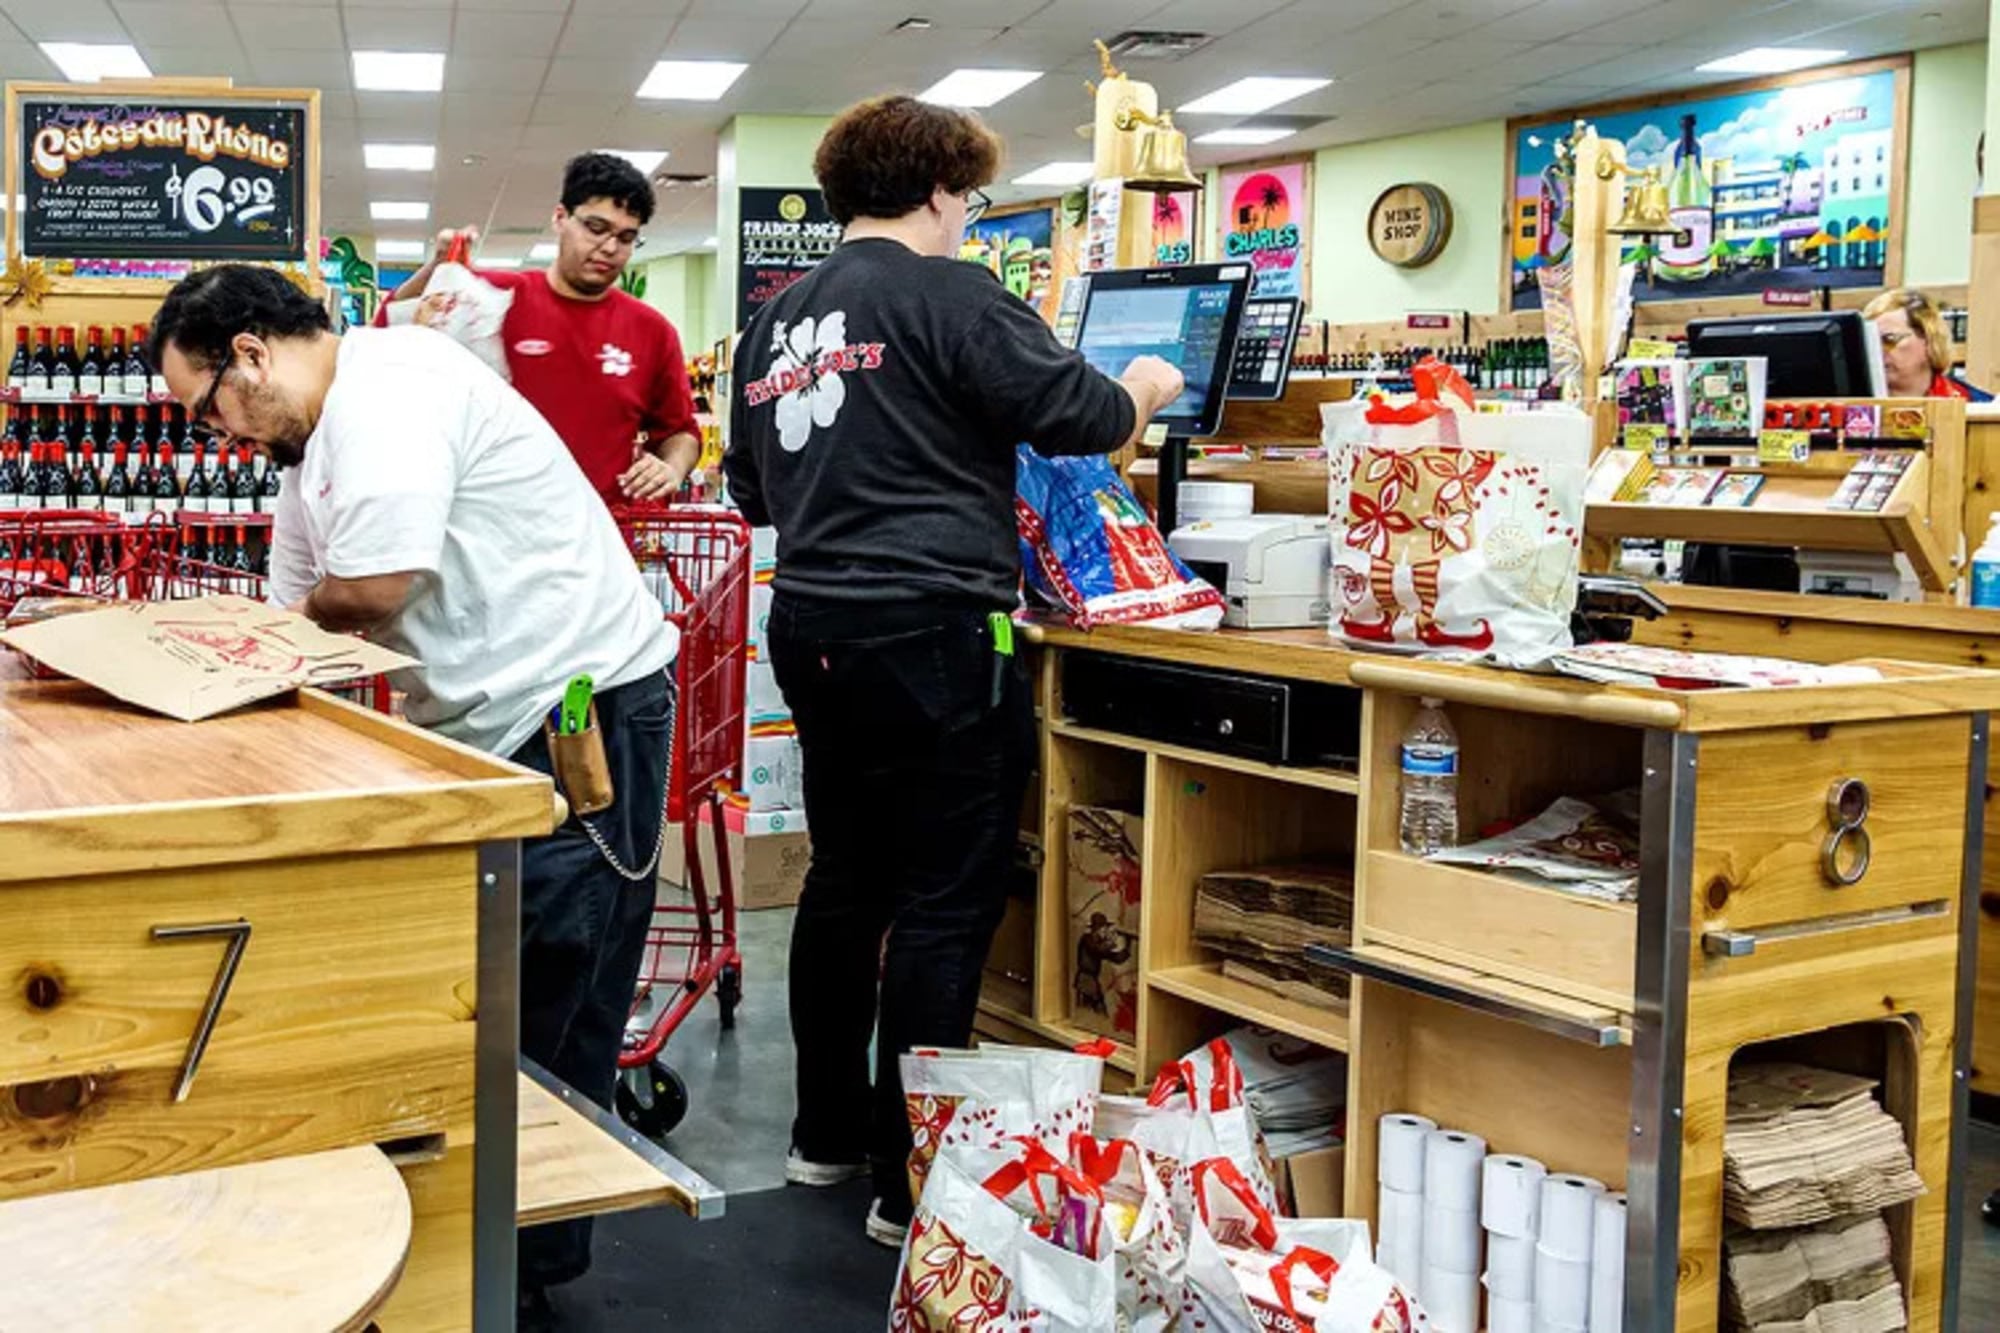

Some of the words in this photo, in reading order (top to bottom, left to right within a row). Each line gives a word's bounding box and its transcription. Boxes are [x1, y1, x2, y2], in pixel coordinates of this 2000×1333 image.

[165, 163, 275, 232] $6.99
[1384, 206, 1422, 223] WINE
[743, 221, 800, 237] TRADER
[1225, 223, 1299, 257] CHARLES
[1383, 224, 1422, 241] SHOP
[1822, 777, 1870, 887] 8
[150, 917, 251, 1104] 7
